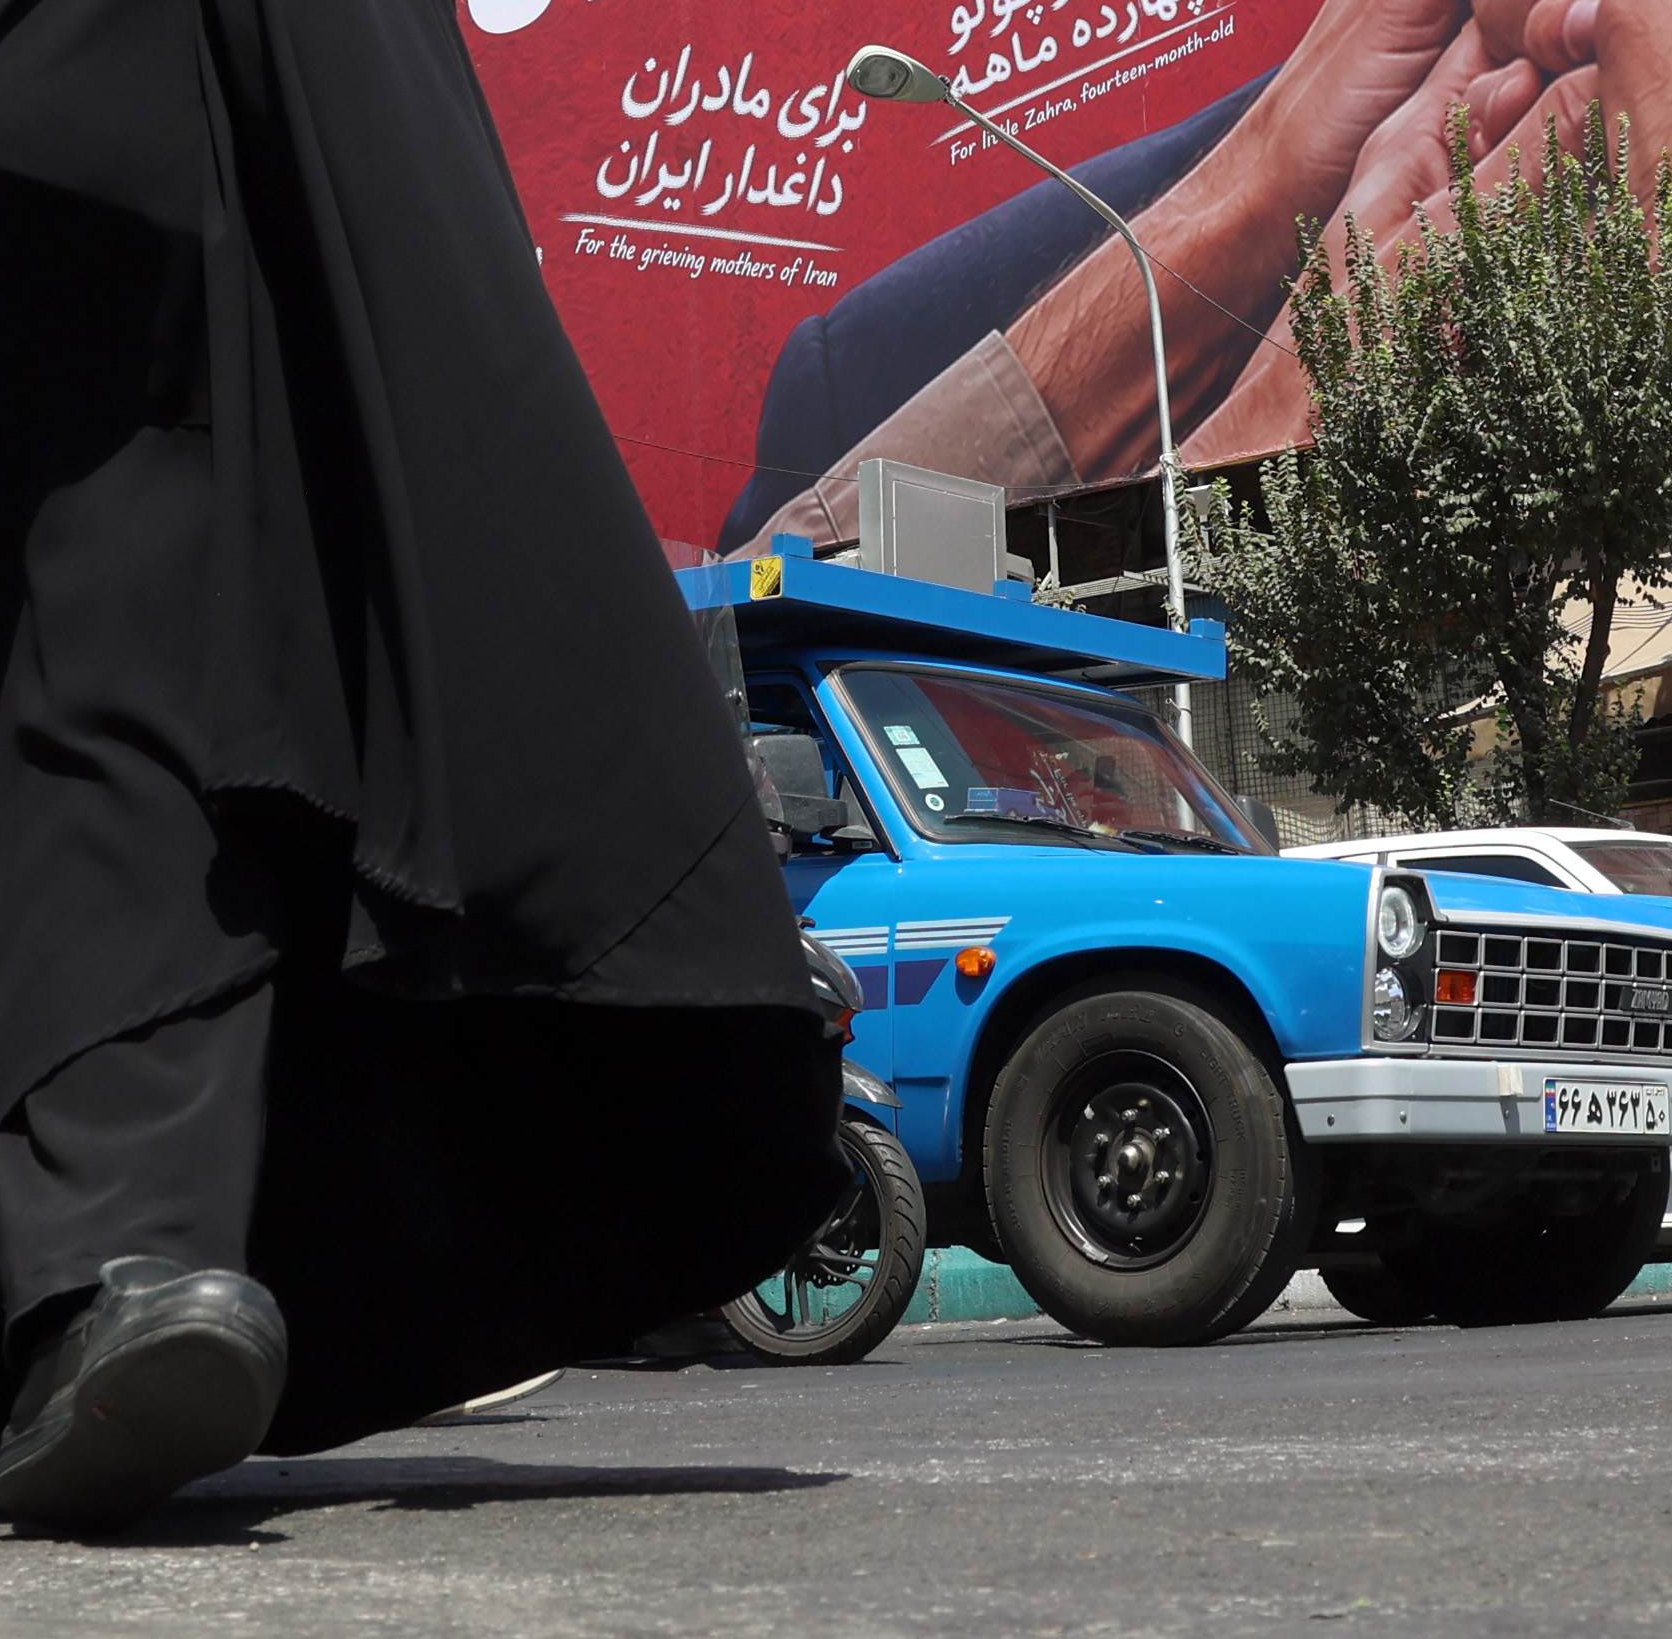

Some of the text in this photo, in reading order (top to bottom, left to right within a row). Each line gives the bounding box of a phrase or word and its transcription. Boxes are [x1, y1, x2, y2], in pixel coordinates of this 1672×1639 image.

[620, 43, 869, 156] برای مادران
[948, 30, 1058, 96] ماهه
[950, 140, 977, 166] For
[1024, 96, 1077, 130] Zahra,
[1080, 15, 1235, 103] fourteen-month-old
[596, 130, 844, 217] داغدار ایران
[576, 229, 837, 286] For the grieving mothers of Iran
[1201, 1048, 1227, 1084] LIGHT
[1227, 1091, 1246, 1143] TRUCK
